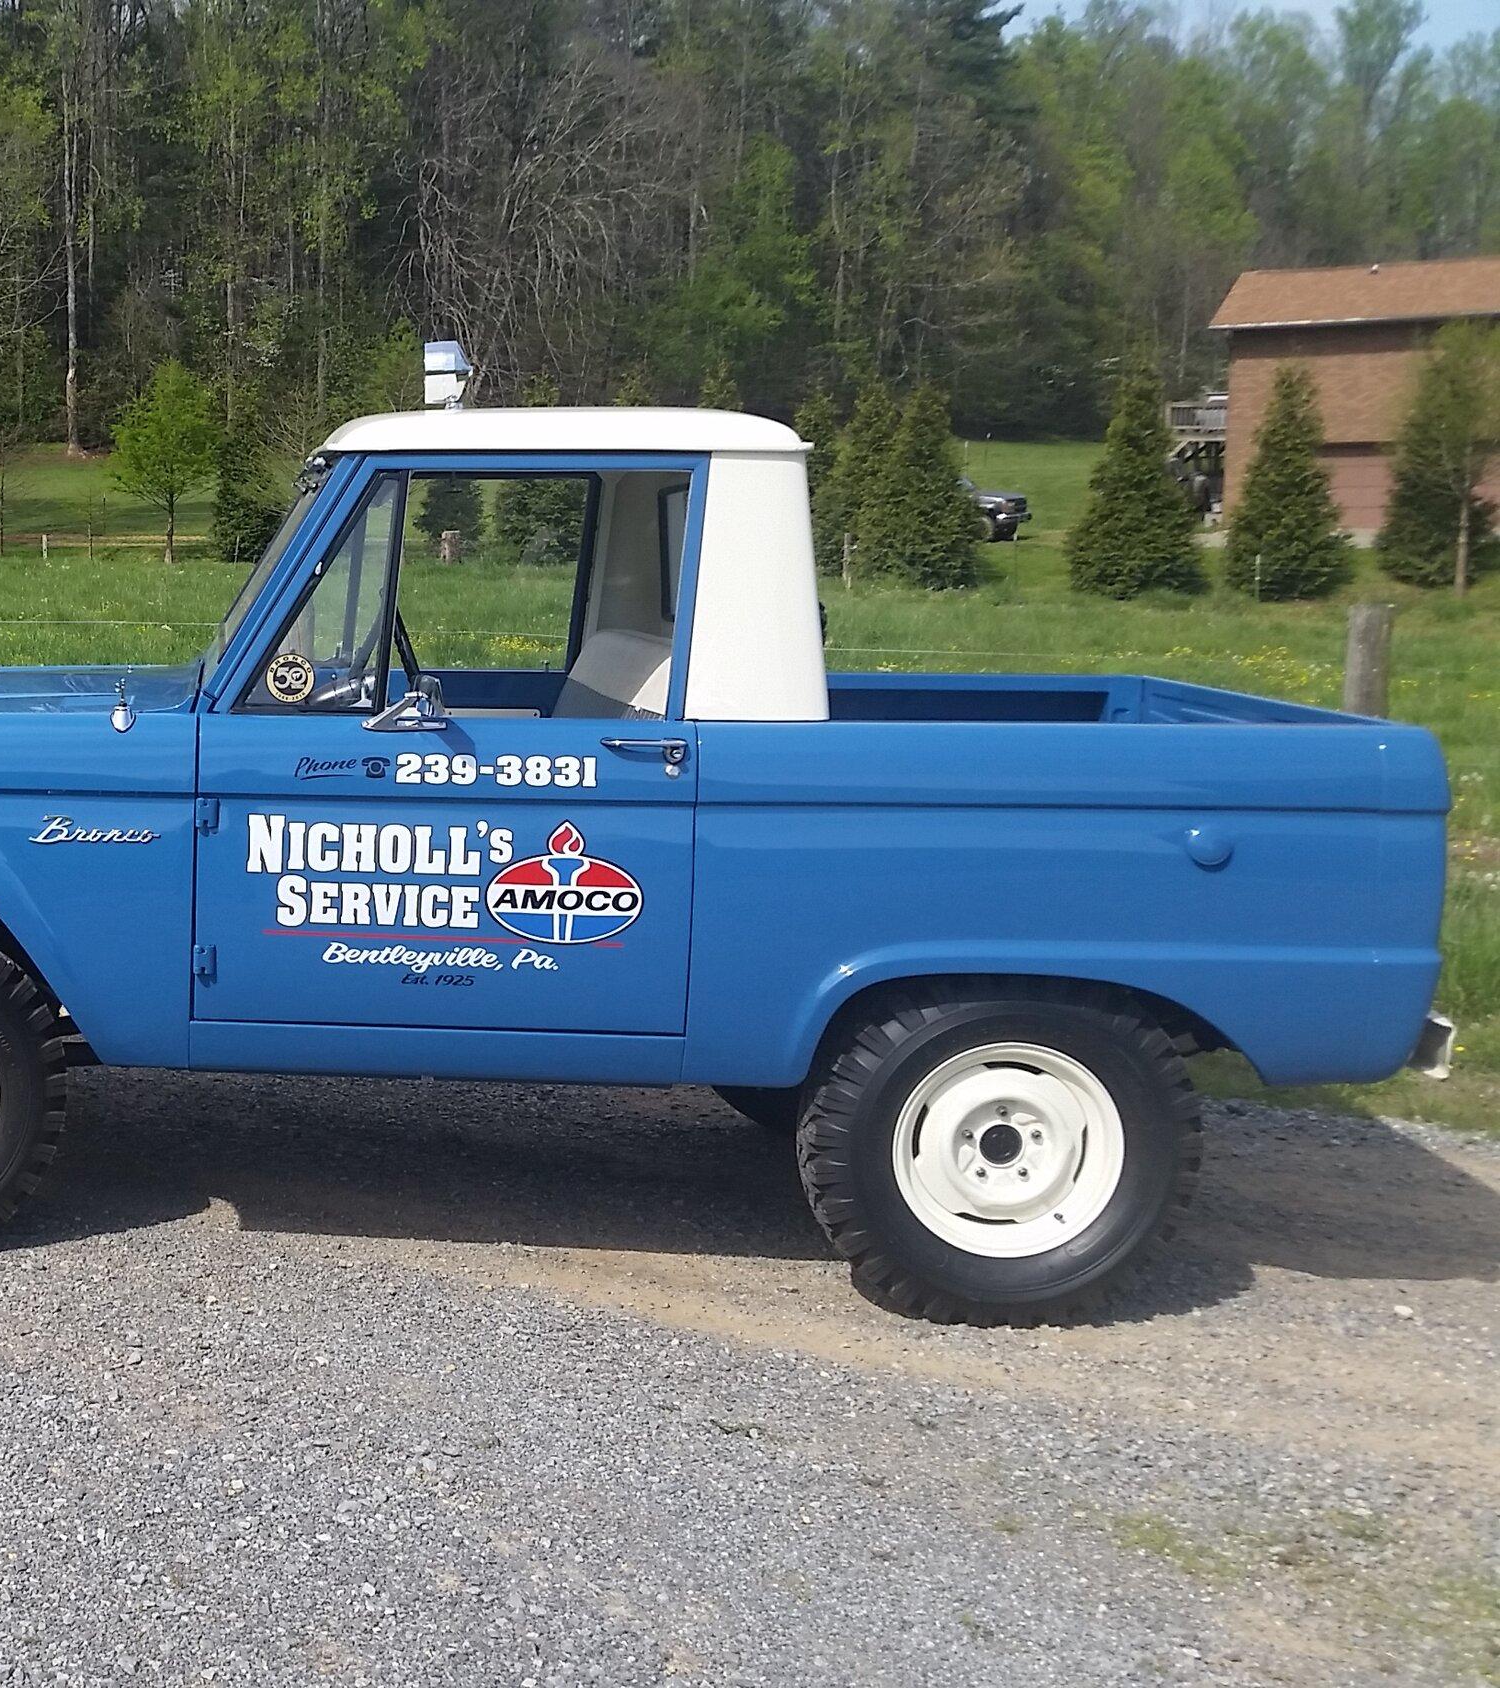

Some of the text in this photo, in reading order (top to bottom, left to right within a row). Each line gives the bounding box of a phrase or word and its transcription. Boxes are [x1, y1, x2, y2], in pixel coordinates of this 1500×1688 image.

[269, 656, 312, 673] BRONCO
[274, 666, 306, 689] 50
[294, 753, 597, 788] Phone 239-3831
[28, 814, 161, 844] Bronco
[275, 873, 481, 930] SERVICE
[491, 888, 640, 913] AMOCO
[321, 941, 560, 974] Bentleyville, Pa.
[401, 973, 476, 987] Est. 1925
